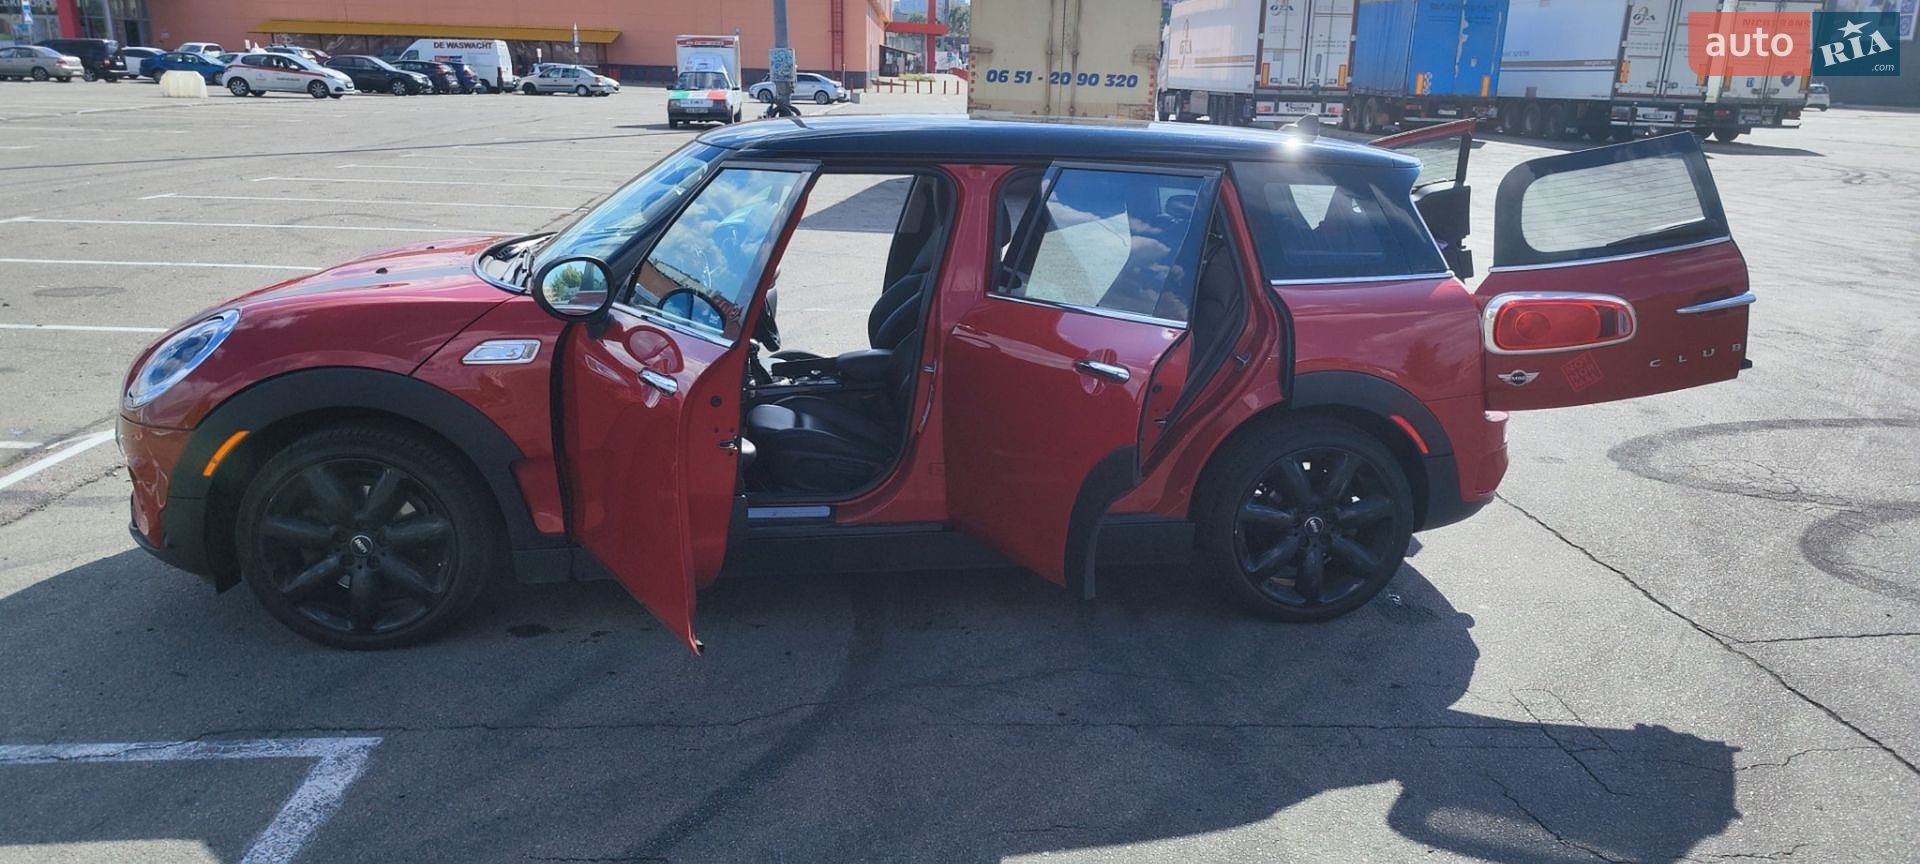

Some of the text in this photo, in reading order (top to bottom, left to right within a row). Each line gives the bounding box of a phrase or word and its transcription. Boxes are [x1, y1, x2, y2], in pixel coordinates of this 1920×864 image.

[985, 69, 1009, 83] 06
[1014, 70, 1033, 84] 51
[1049, 71, 1072, 86] 20
[1076, 73, 1100, 86] 90
[1104, 74, 1138, 88] 320
[1649, 343, 1742, 367] CLUB
